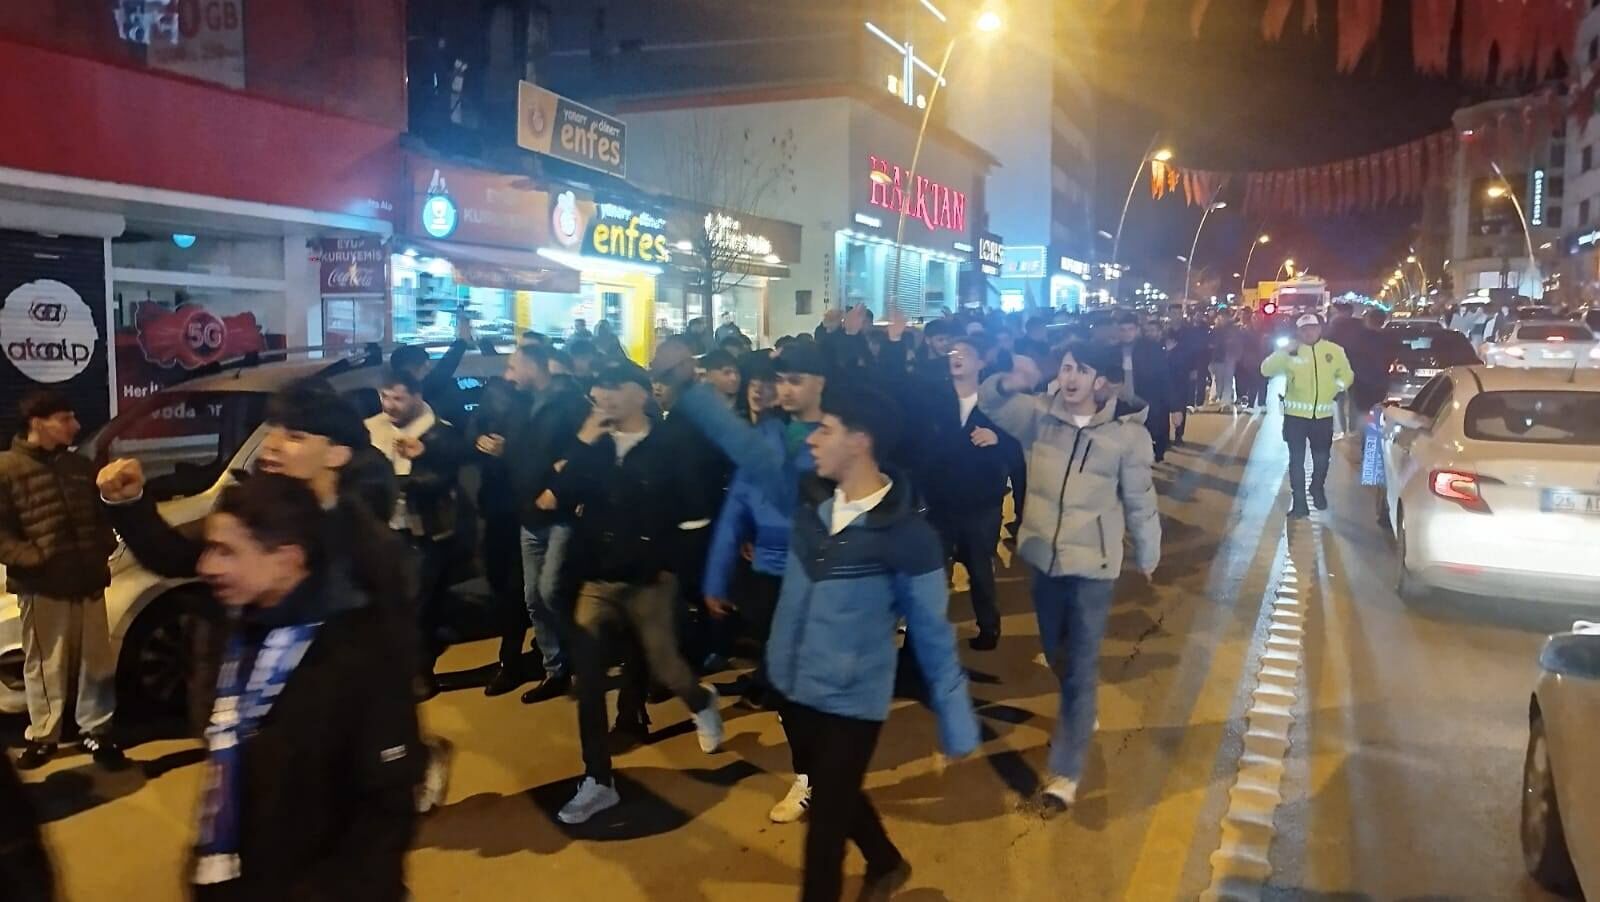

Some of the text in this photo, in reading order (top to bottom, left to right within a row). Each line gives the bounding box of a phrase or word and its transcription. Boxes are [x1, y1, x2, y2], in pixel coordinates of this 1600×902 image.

[561, 122, 620, 166] enfes
[593, 215, 669, 263] enfes
[188, 322, 222, 348] 5G
[123, 385, 148, 398] Her
